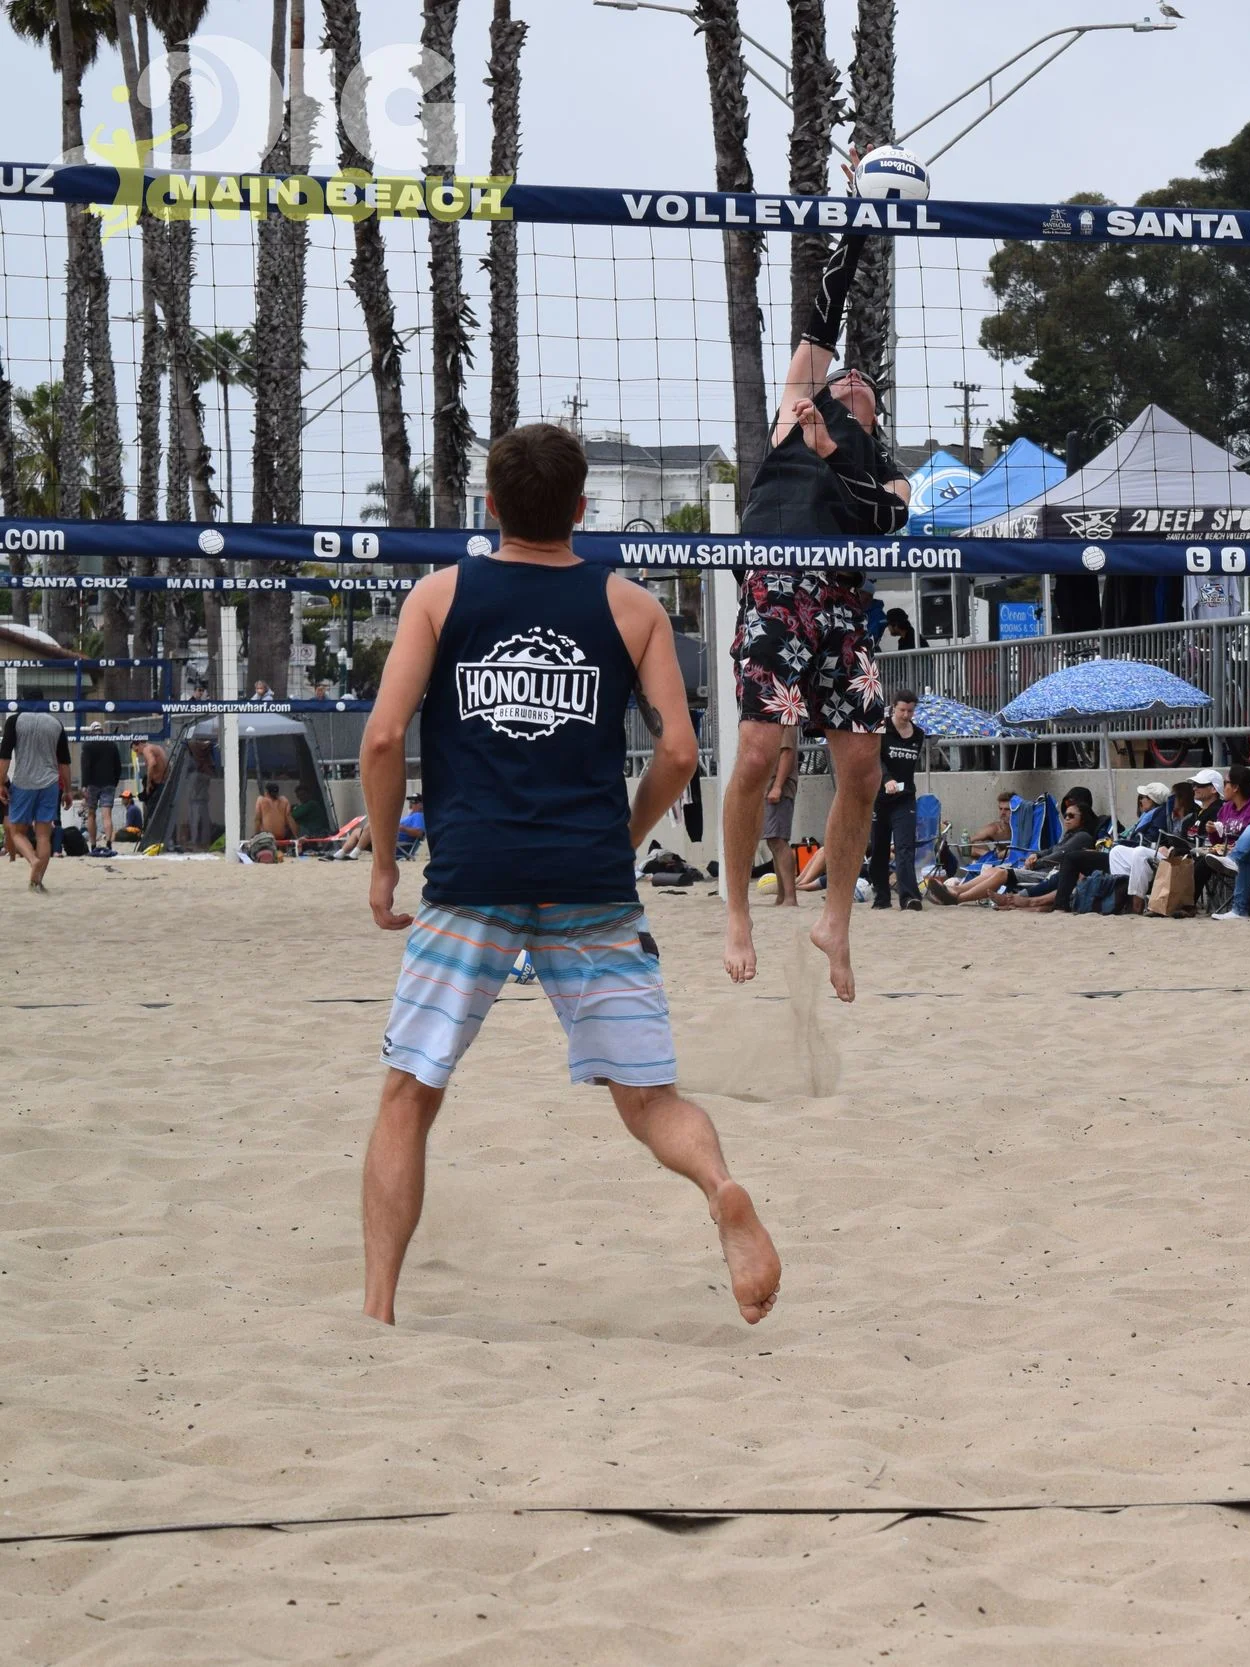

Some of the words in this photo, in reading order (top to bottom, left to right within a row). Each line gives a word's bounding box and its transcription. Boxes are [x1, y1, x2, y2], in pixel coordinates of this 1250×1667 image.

[879, 160, 916, 175] Wilson
[169, 174, 300, 205] MAIN
[325, 182, 502, 214] BEACH
[621, 193, 940, 230] VOLLEYBALL
[1106, 211, 1243, 239] SANTA
[1127, 508, 1204, 532] 2DEEP
[620, 540, 962, 569] www.santacruzwharf.com
[22, 577, 77, 587] SANTA
[81, 578, 128, 588] CRUZ
[167, 579, 215, 589] MAIN
[222, 579, 286, 589] BEACH
[329, 579, 412, 590] VOLLEYB
[0, 659, 43, 668] EYBALL
[465, 669, 589, 712] HONOLULU
[161, 701, 291, 714] www.santacruzwharf.com
[499, 707, 549, 720] BEERWORKS
